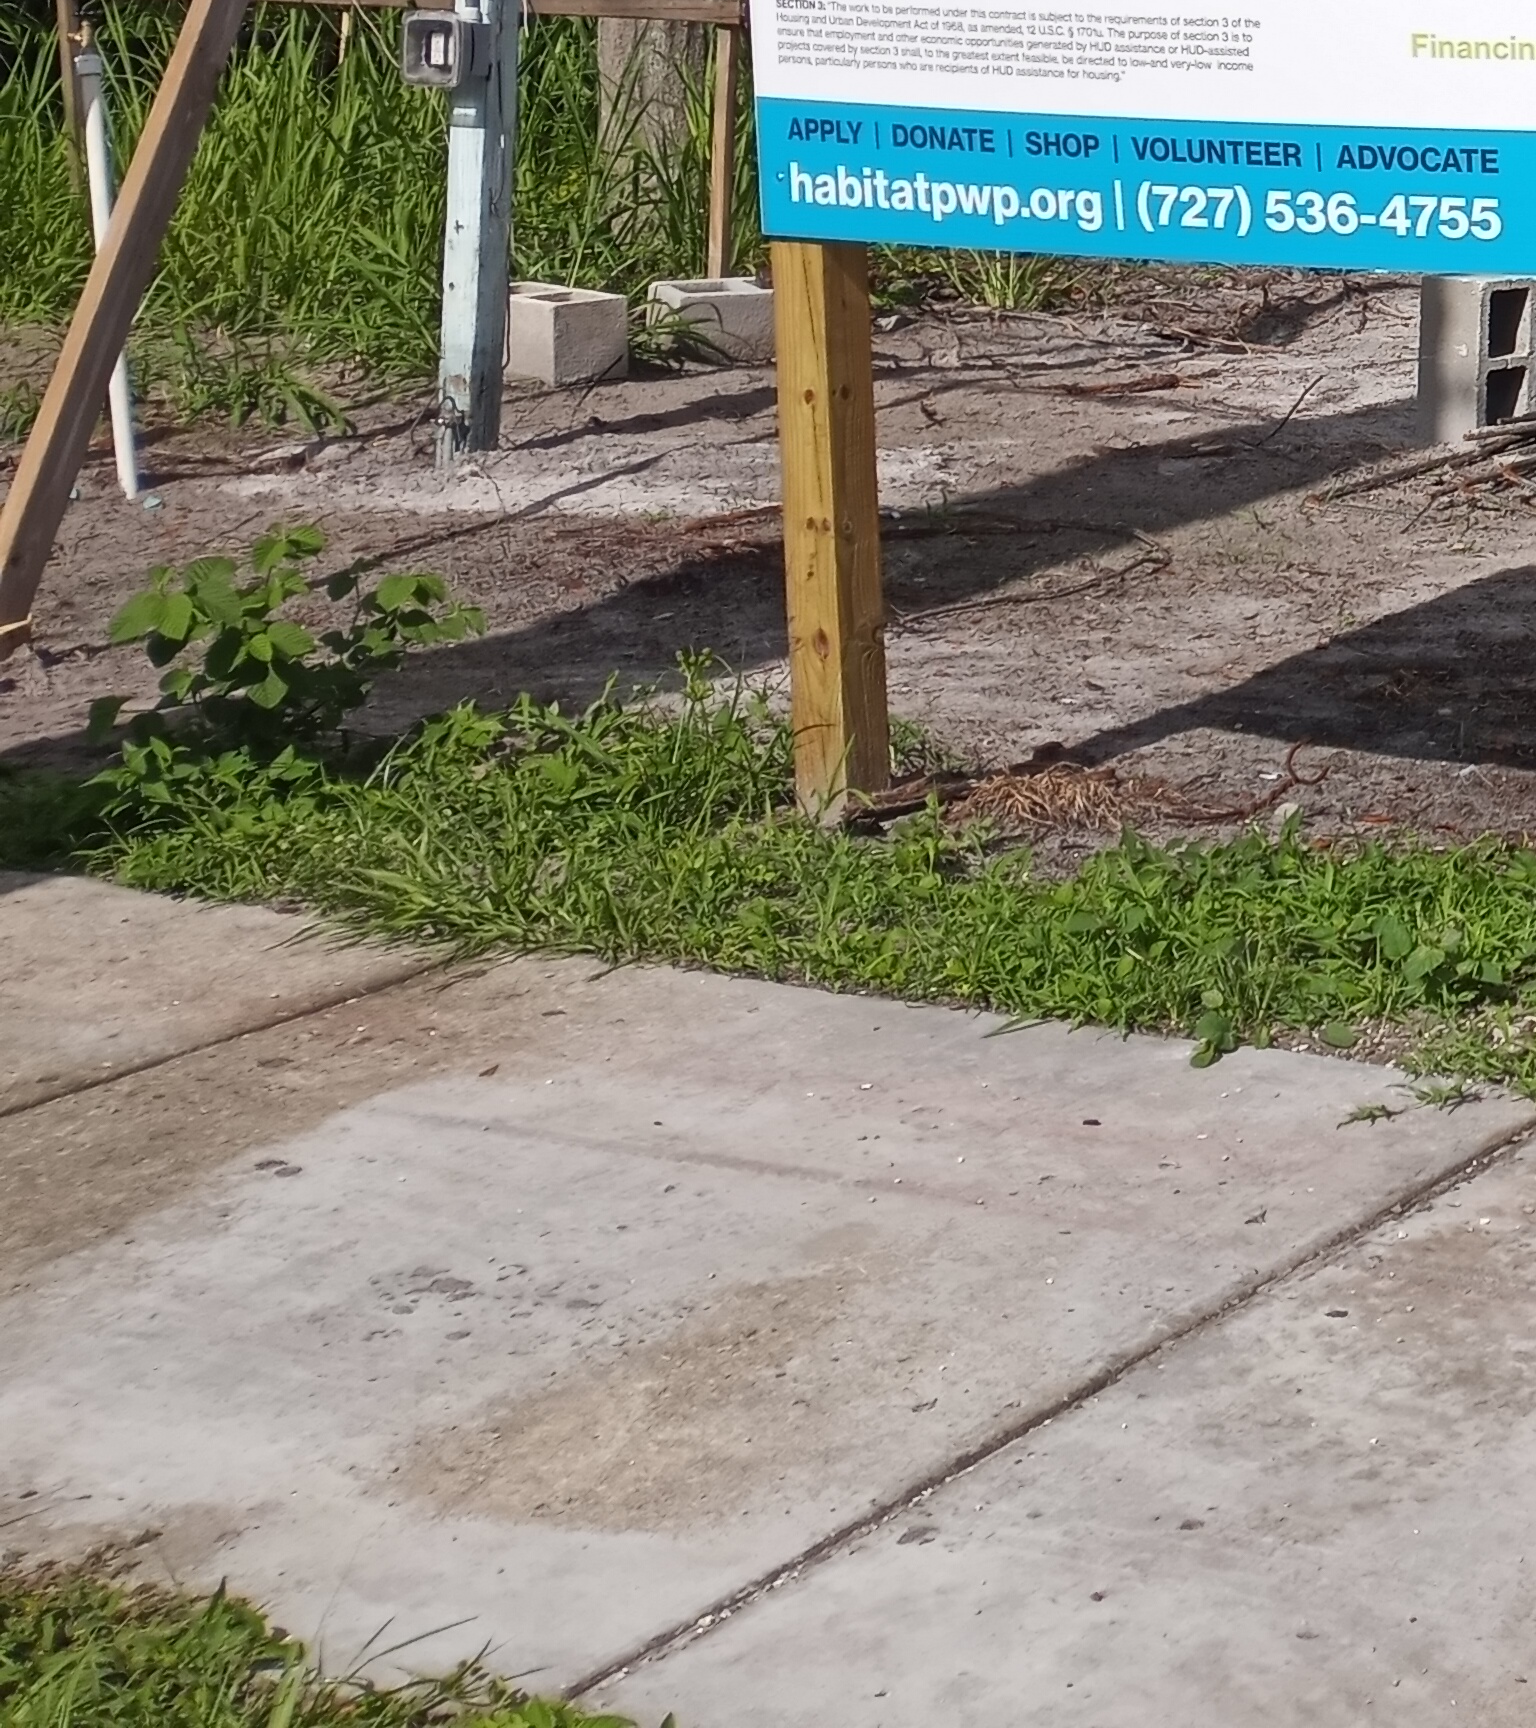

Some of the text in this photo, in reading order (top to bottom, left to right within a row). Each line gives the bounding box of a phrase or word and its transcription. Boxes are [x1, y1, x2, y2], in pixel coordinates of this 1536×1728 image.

[776, 0, 815, 10] SECTION
[1104, 13, 1167, 26] requirements
[1183, 16, 1219, 27] section
[1245, 18, 1260, 29] the
[1108, 26, 1125, 37] The
[1129, 30, 1167, 41] purpose
[1183, 31, 1219, 41] section
[992, 64, 1013, 75] HUD
[788, 118, 1499, 173] APPLY DONATE SHOP VOLUNTEER ADVOCATE
[790, 162, 1503, 241] habitatpwp.org (727) 536-4755
